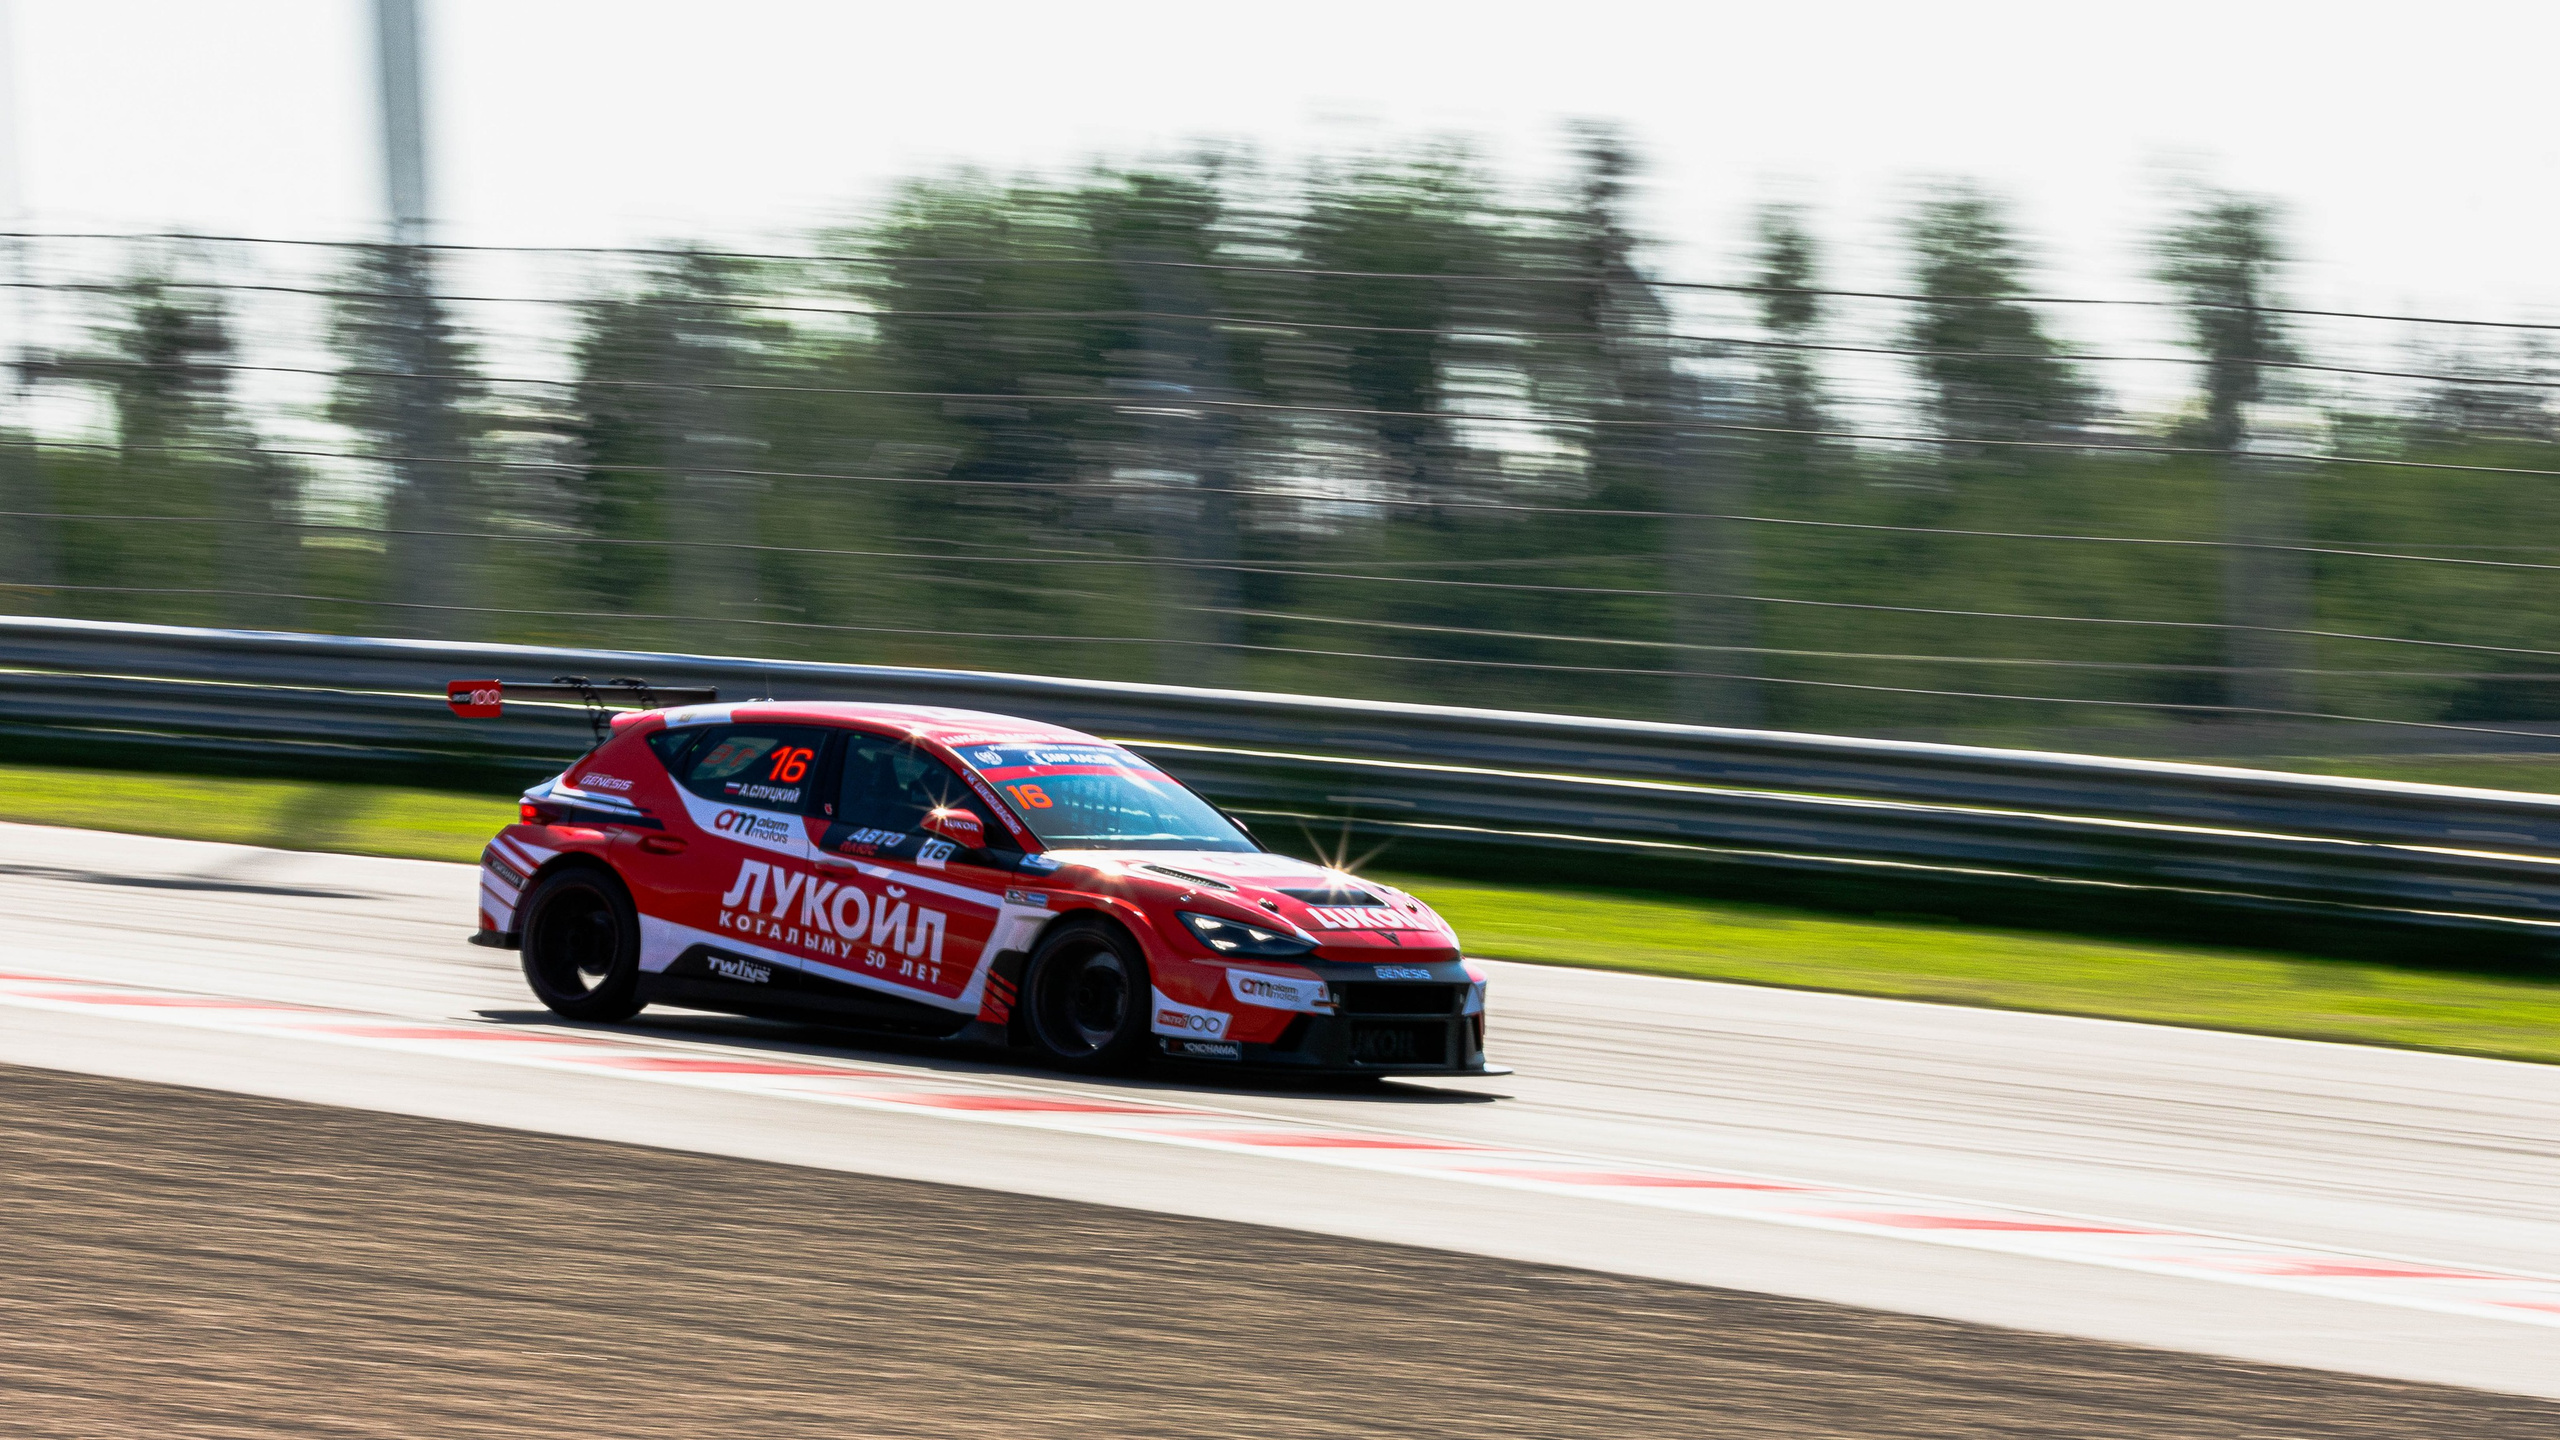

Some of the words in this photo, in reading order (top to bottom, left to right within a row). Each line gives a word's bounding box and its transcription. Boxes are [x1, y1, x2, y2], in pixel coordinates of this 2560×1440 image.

[769, 744, 815, 783] 16
[580, 774, 634, 791] GENESIS
[738, 783, 801, 804] А.СЛУЦКИЙ
[1006, 783, 1053, 810] 16
[750, 828, 788, 844] motors
[847, 827, 907, 848] АВТО
[922, 841, 952, 860] 16
[722, 858, 947, 964] ЛУКОЙЛ
[1305, 907, 1432, 931] LUKOIL
[719, 910, 852, 959] КОГАЛЫМУ
[865, 949, 887, 969] 50
[900, 962, 941, 984] ЛЕТ
[1376, 968, 1432, 980] GENESIS
[1183, 1041, 1237, 1056] YOKOHAMA
